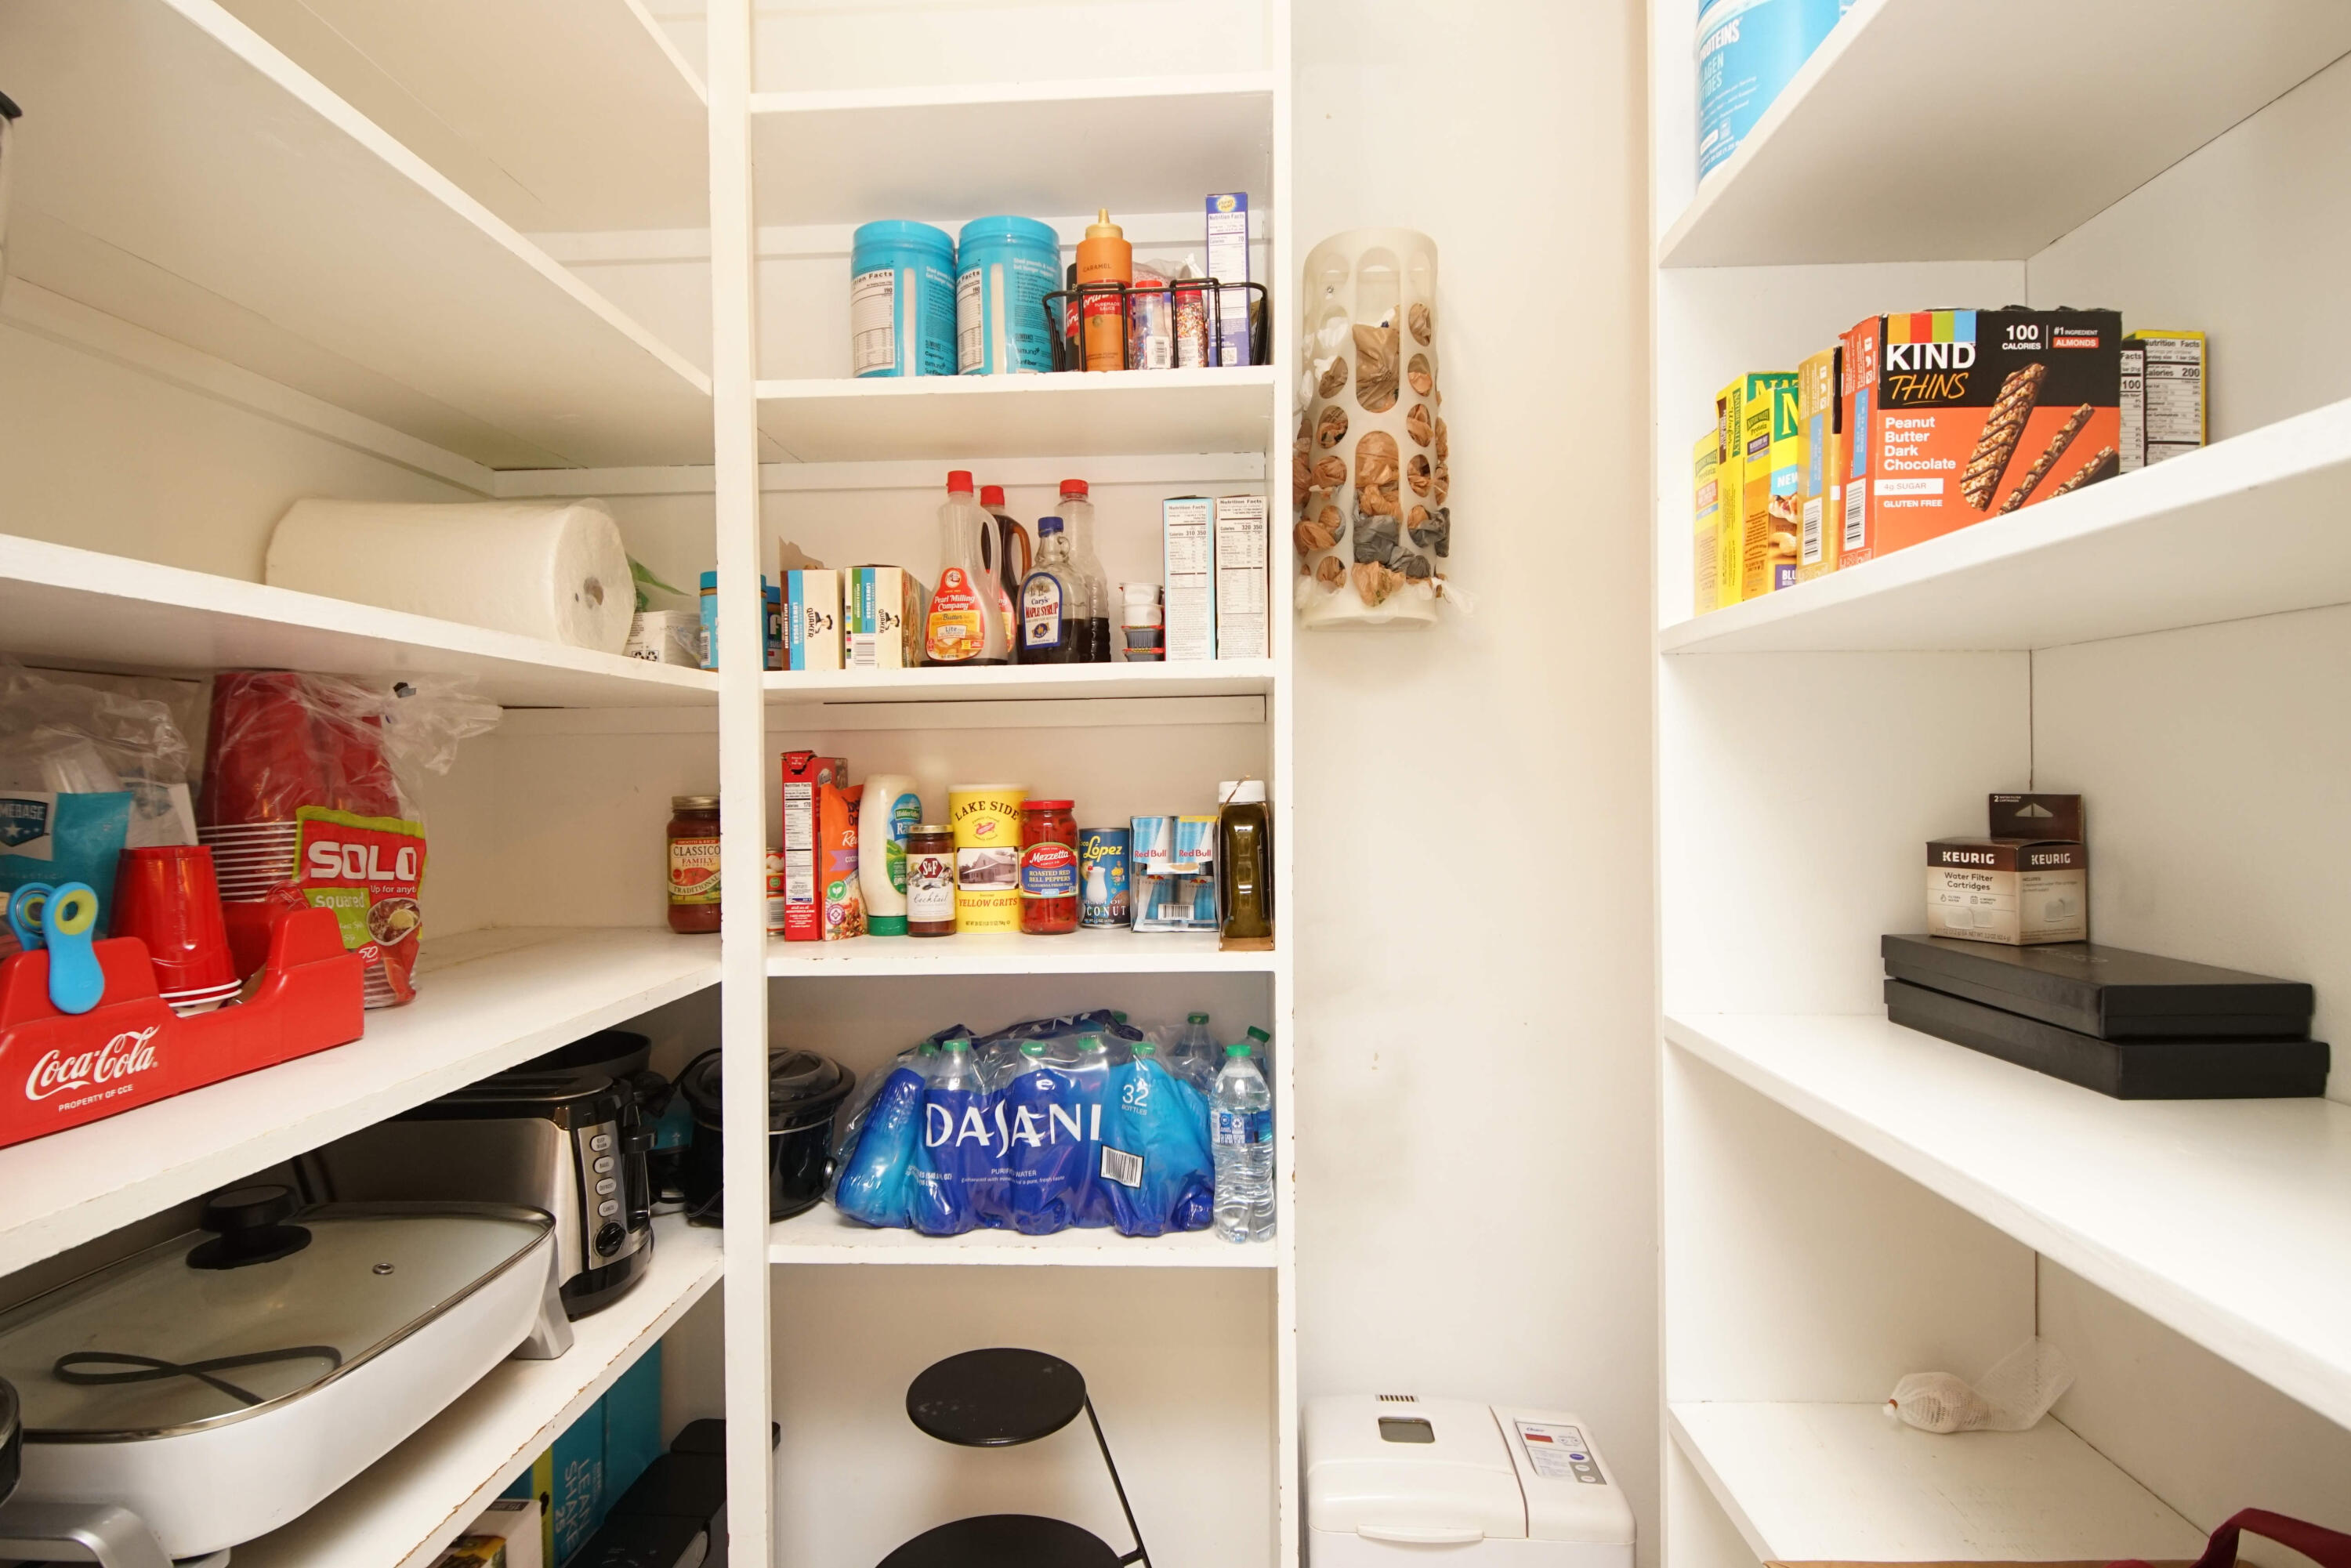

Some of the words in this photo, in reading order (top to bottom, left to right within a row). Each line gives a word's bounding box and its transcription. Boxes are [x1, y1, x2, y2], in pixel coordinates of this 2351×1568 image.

[1083, 263, 1111, 272] CARAMEL
[868, 271, 893, 280] Facts
[962, 270, 980, 281] Facts
[2006, 325, 2038, 340] 100
[2054, 326, 2064, 335] #1
[2056, 339, 2096, 347] ALMONDS
[1886, 342, 1976, 371] KIND
[2182, 368, 2200, 377] 200
[1889, 372, 1969, 400] THINS
[2122, 380, 2142, 389] 100
[1885, 416, 1936, 429] Peanut
[1885, 431, 1930, 443] Butter
[1885, 444, 1918, 457] Dark
[1884, 458, 1957, 470] Chocolate
[950, 594, 976, 603] Milling
[1031, 596, 1049, 605] Cary's
[938, 603, 969, 612] Company
[1026, 607, 1041, 618] MAPLE
[1041, 602, 1059, 616] SYRUP
[955, 801, 985, 821] LAKE
[990, 801, 1020, 820] SIDE
[673, 846, 721, 856] CLASSICO
[1029, 849, 1069, 864] Mezzetta
[1134, 849, 1150, 858] Red
[308, 841, 417, 881] SOLO
[1942, 851, 1994, 864] KEURIG
[2031, 853, 2070, 865] KEURIG
[922, 860, 938, 875] S&F
[1944, 871, 1969, 880] Water
[1971, 873, 1994, 882] Filter
[371, 885, 380, 894] Up
[397, 885, 416, 895] anyt
[674, 875, 719, 894] TRADITIONAL
[1947, 880, 1991, 891] Cartridges
[914, 891, 948, 904] Cocktail
[959, 899, 991, 907] YELLOW
[993, 897, 1017, 906] GRITS
[358, 945, 378, 959] 50
[26, 1025, 161, 1100] Coca-Cola
[59, 1093, 103, 1112] PROPERTY
[105, 1089, 117, 1099] OF
[118, 1085, 134, 1095] CCE
[1122, 1085, 1147, 1106] 32
[1121, 1104, 1147, 1116] BOTTLES
[926, 1099, 1102, 1158] DASANI
[578, 1458, 591, 1530] LEAN
[564, 1460, 578, 1553] SHAKE
